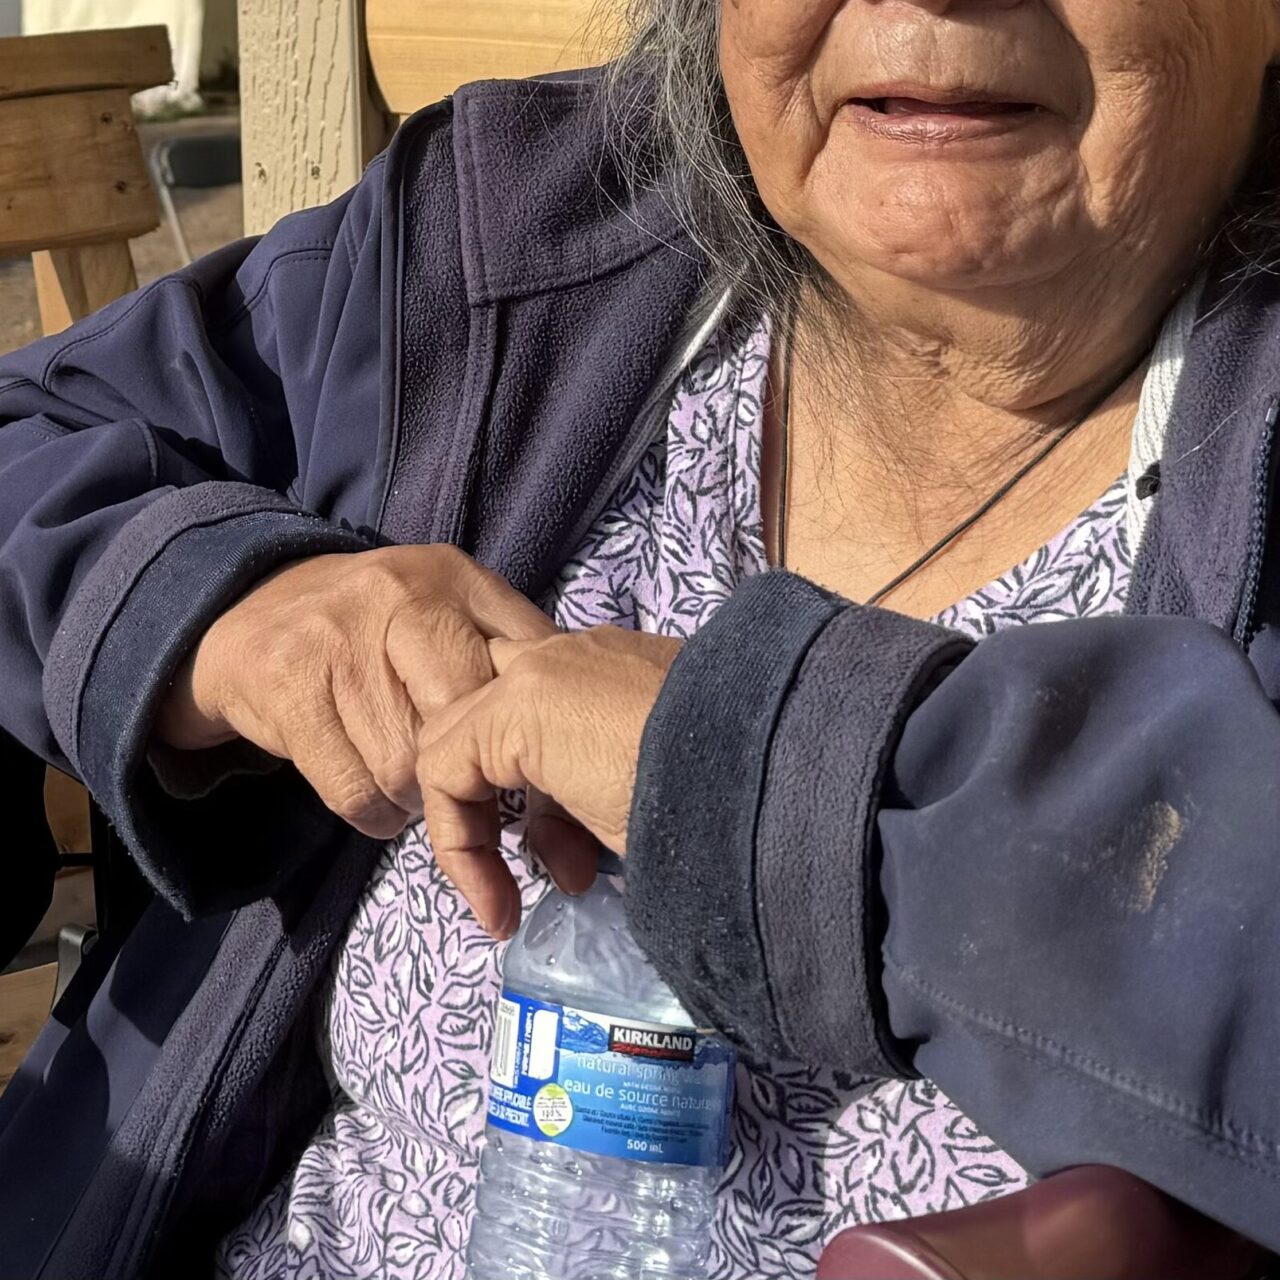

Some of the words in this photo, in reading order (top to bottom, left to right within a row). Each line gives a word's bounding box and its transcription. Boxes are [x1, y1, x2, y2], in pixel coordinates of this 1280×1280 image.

[613, 1027, 693, 1050] KIRKLAND
[577, 1055, 631, 1076] natural
[564, 1079, 591, 1095] eau
[595, 1082, 614, 1099] de
[618, 1089, 669, 1108] source
[627, 1138, 648, 1151] 500
